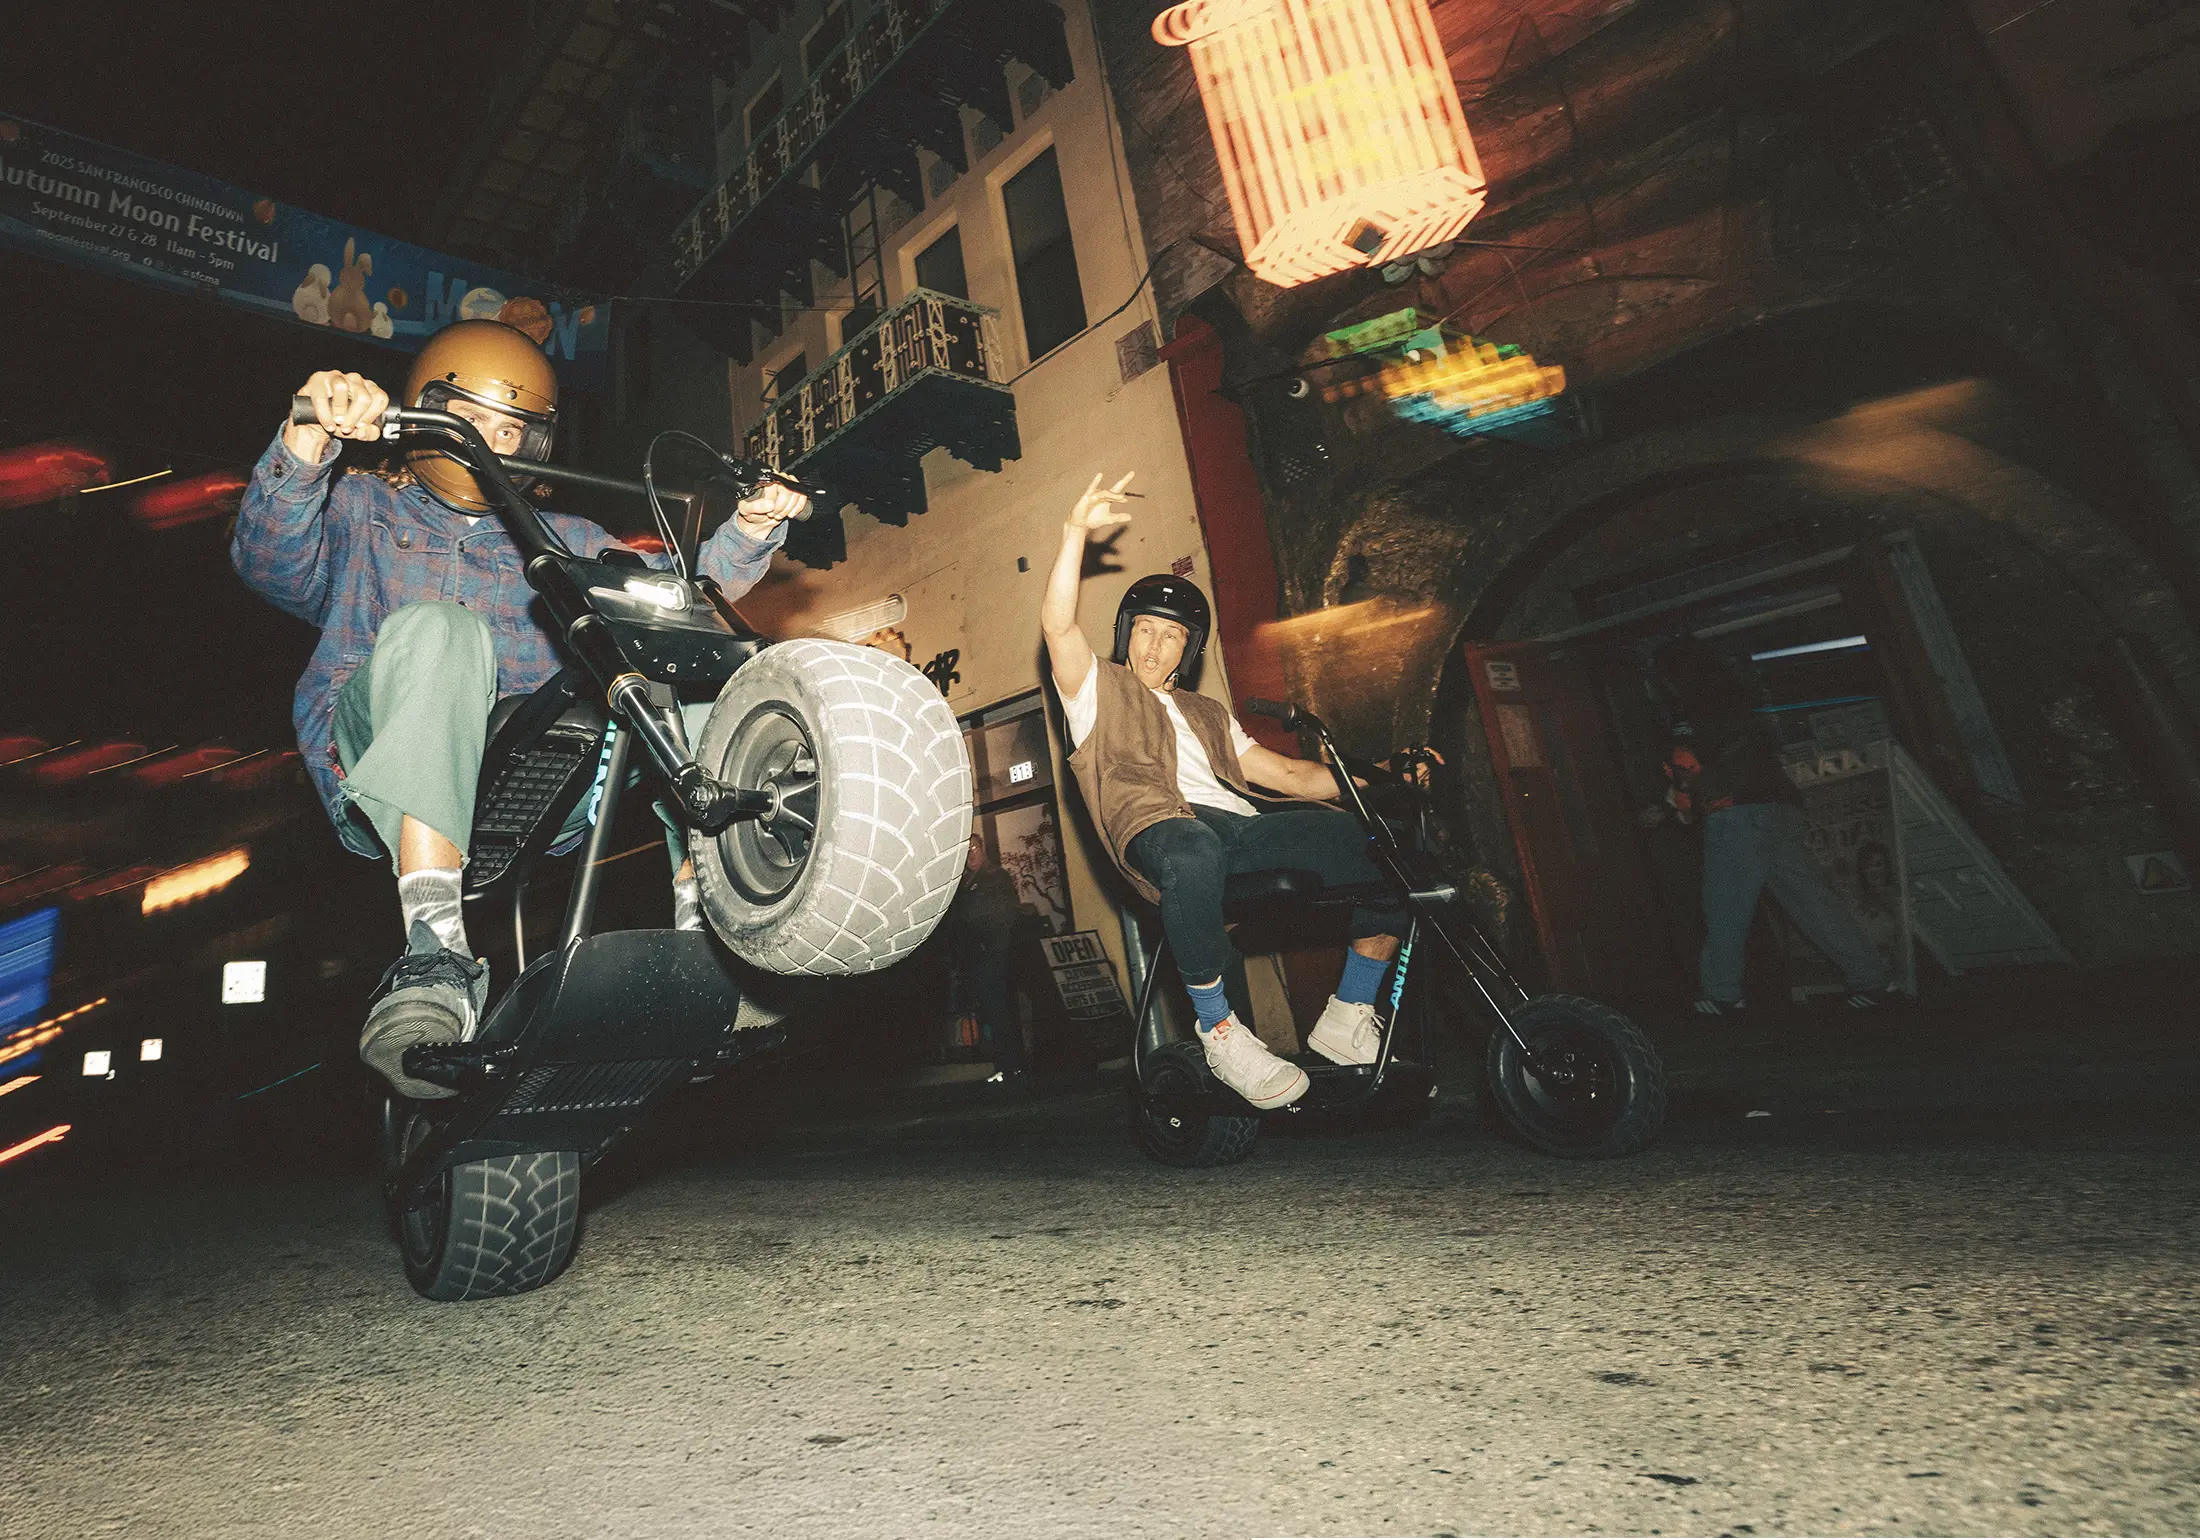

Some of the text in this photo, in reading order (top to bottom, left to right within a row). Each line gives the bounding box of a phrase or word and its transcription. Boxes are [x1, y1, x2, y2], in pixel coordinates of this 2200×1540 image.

[41, 149, 244, 223] 2025 SAN FRANCISCO CHINATOWN
[31, 201, 107, 233] September
[109, 223, 126, 238] 27
[127, 228, 139, 242] &
[140, 232, 158, 247] 28
[166, 239, 196, 259] 11am
[208, 252, 235, 271] 5pm
[35, 228, 131, 262] moonfestival.org
[107, 188, 181, 233] Moon
[187, 214, 279, 263] Festival
[1051, 937, 1097, 963] OPEN
[1390, 940, 1412, 1010] ANTIC
